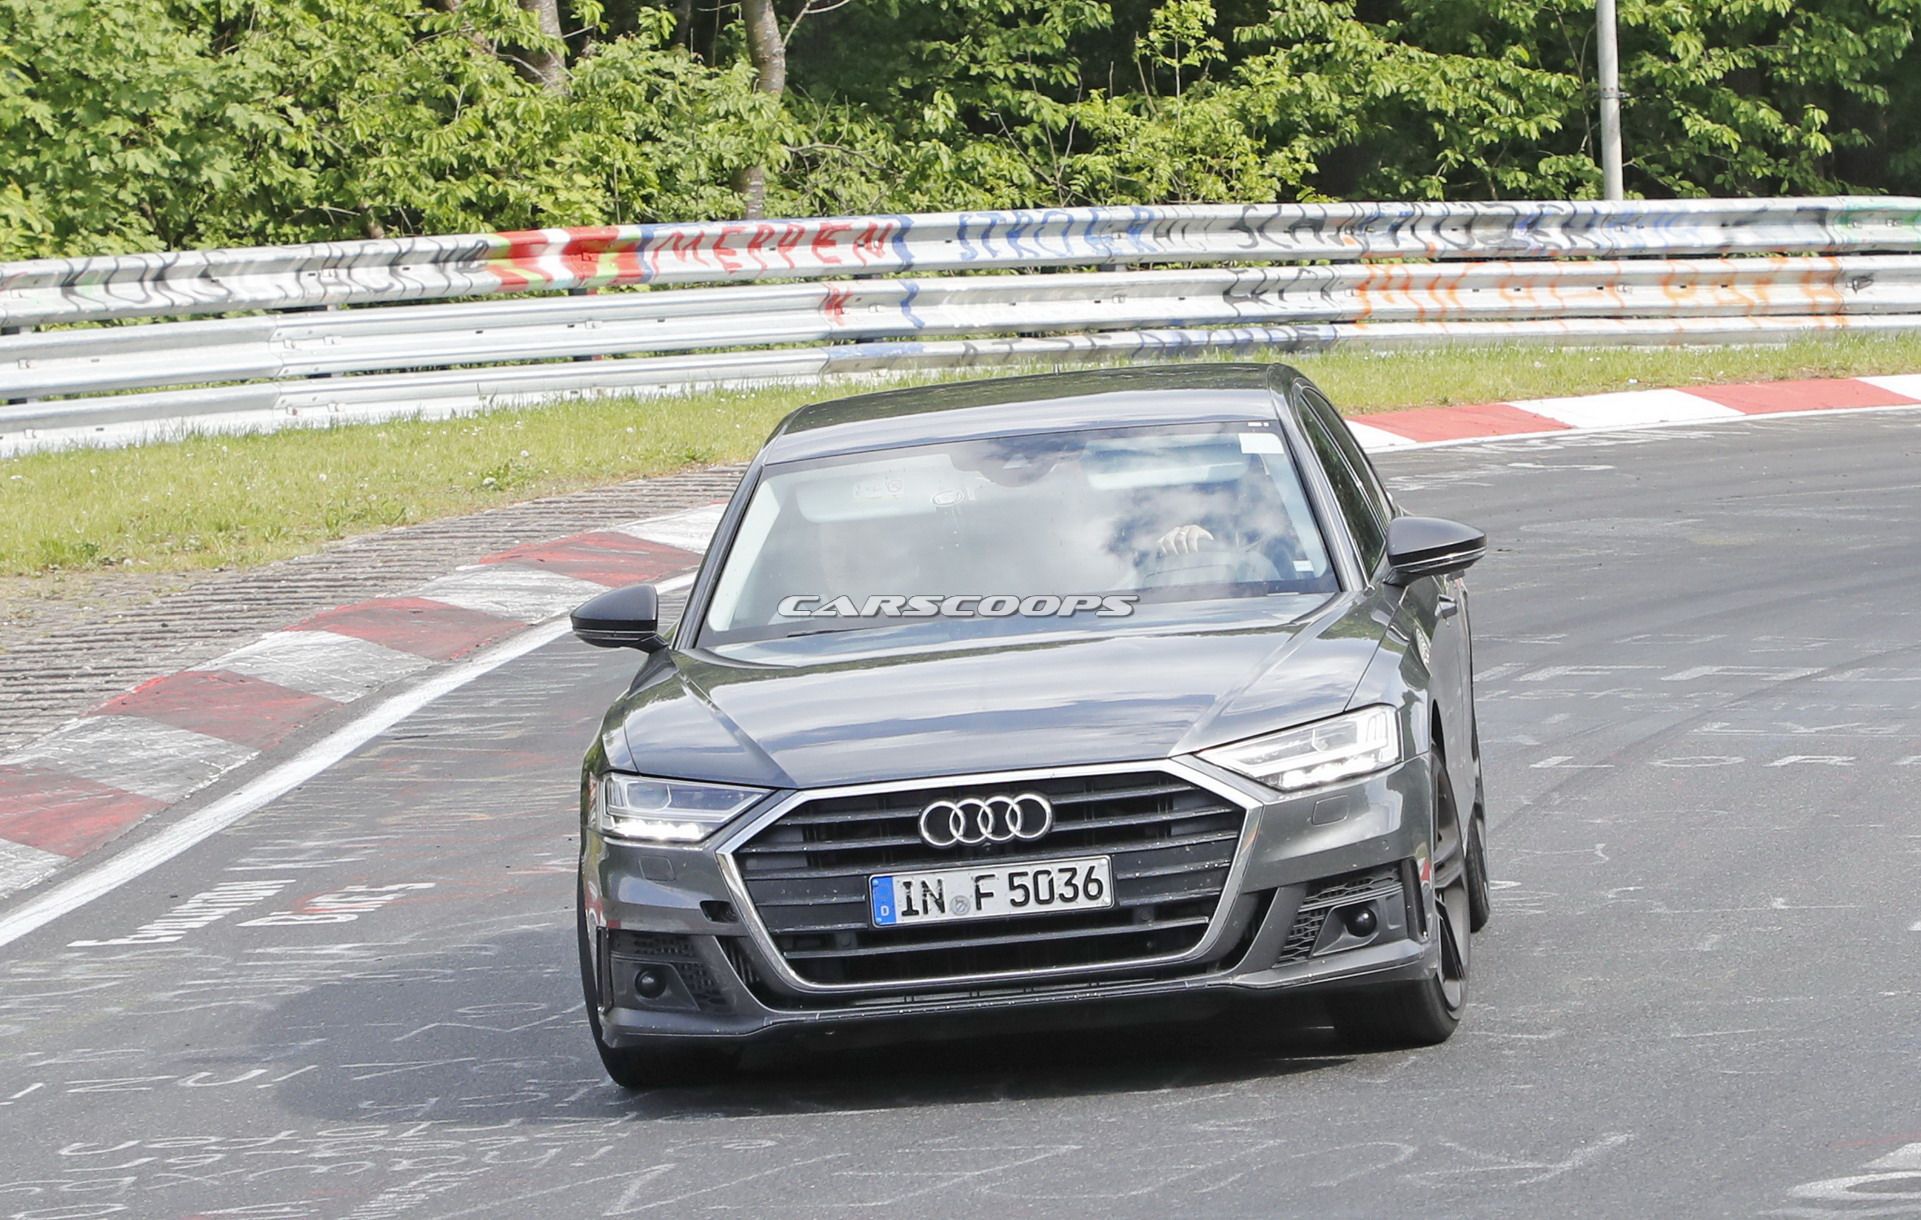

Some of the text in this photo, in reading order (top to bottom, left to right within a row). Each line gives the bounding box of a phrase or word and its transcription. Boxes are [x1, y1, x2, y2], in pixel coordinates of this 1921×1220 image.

[901, 865, 1104, 917] IN F 5036
[880, 905, 890, 917] D
